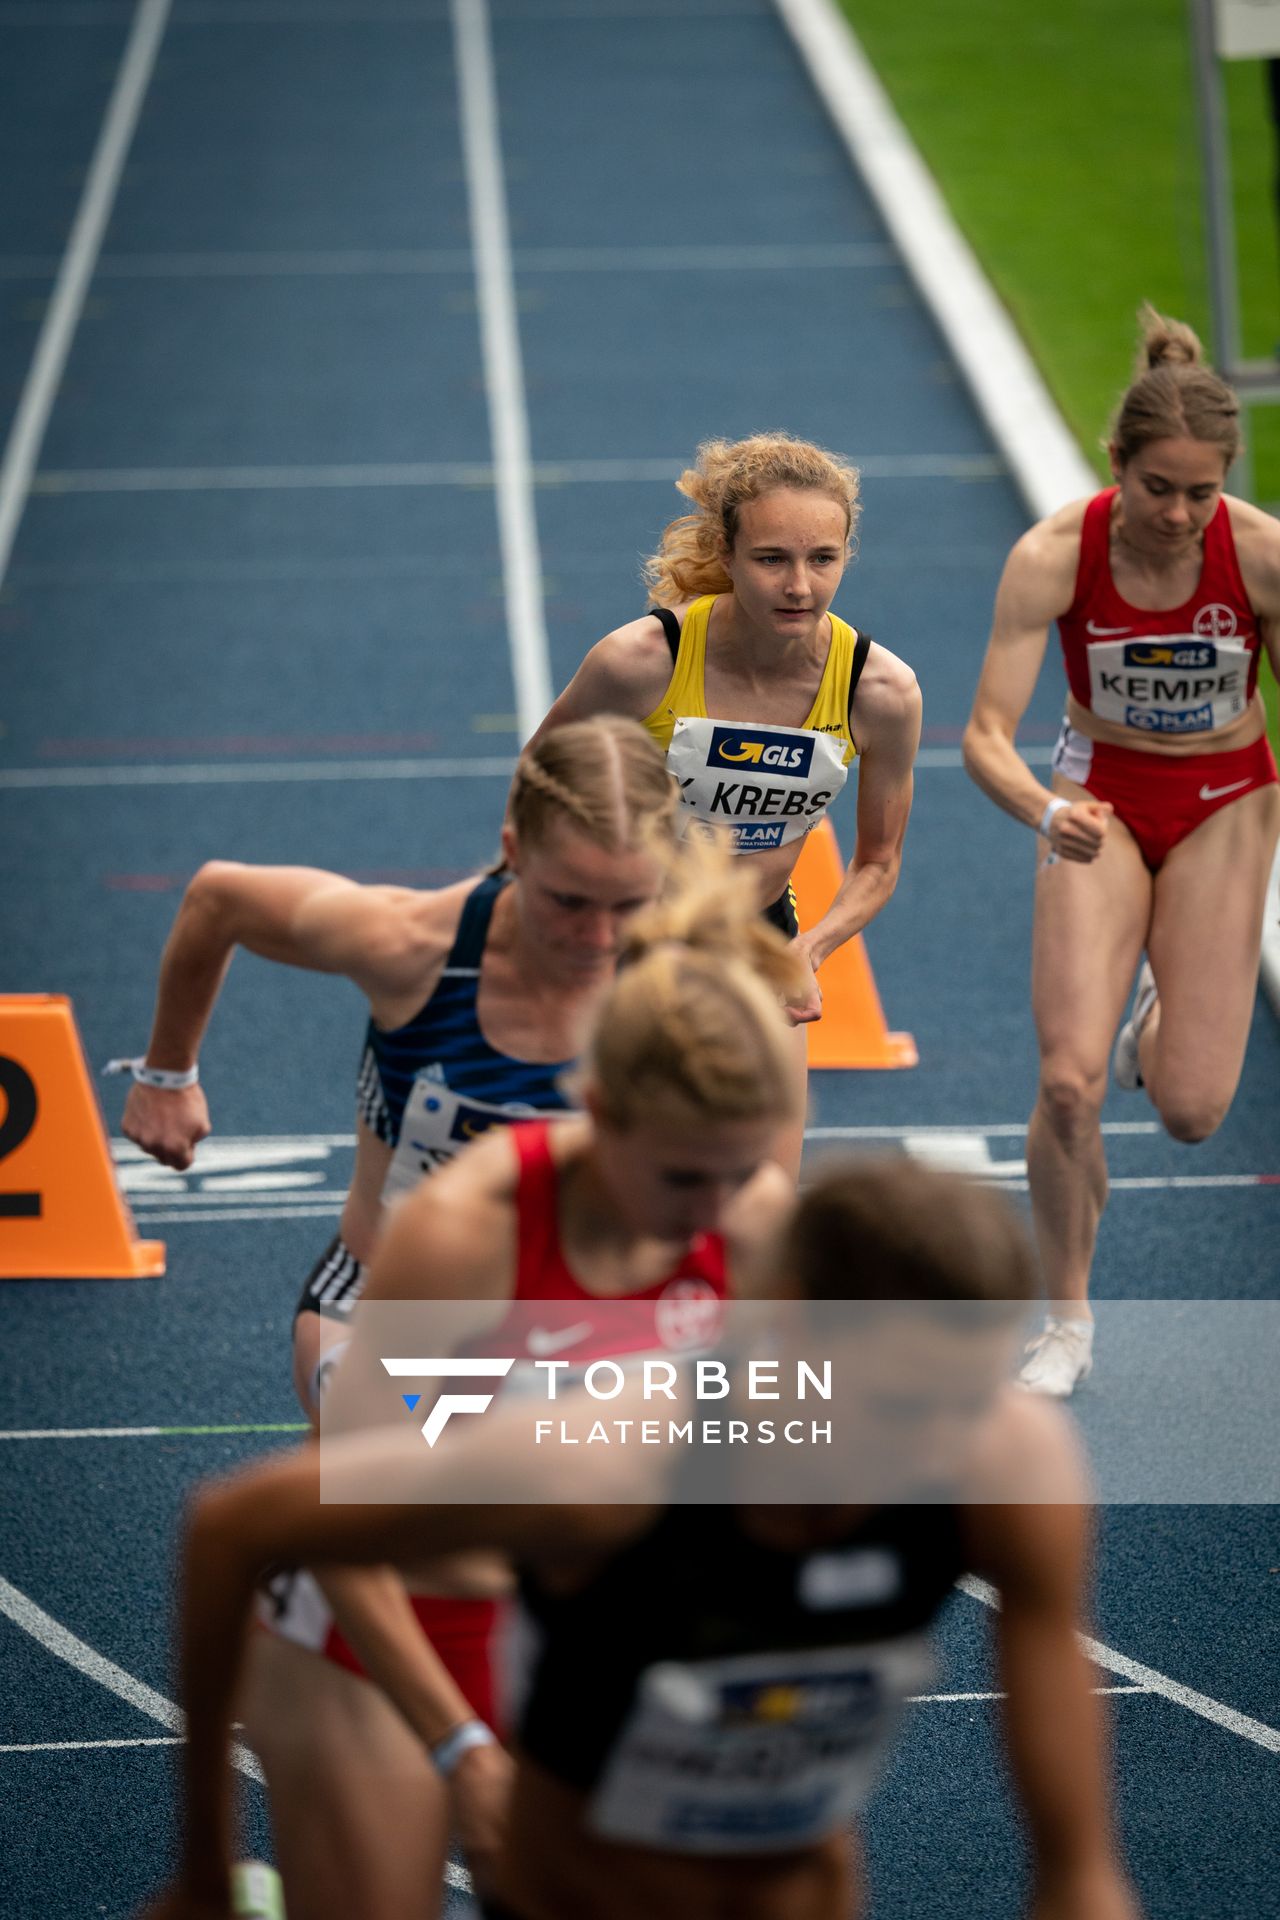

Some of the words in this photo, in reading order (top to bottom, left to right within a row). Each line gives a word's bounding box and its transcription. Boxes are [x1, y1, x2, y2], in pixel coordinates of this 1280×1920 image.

[1174, 649, 1209, 667] GLS
[1101, 670, 1239, 702] KEMPE
[762, 745, 804, 768] GLS
[710, 782, 831, 815] KREBS
[728, 826, 781, 841] PLAN
